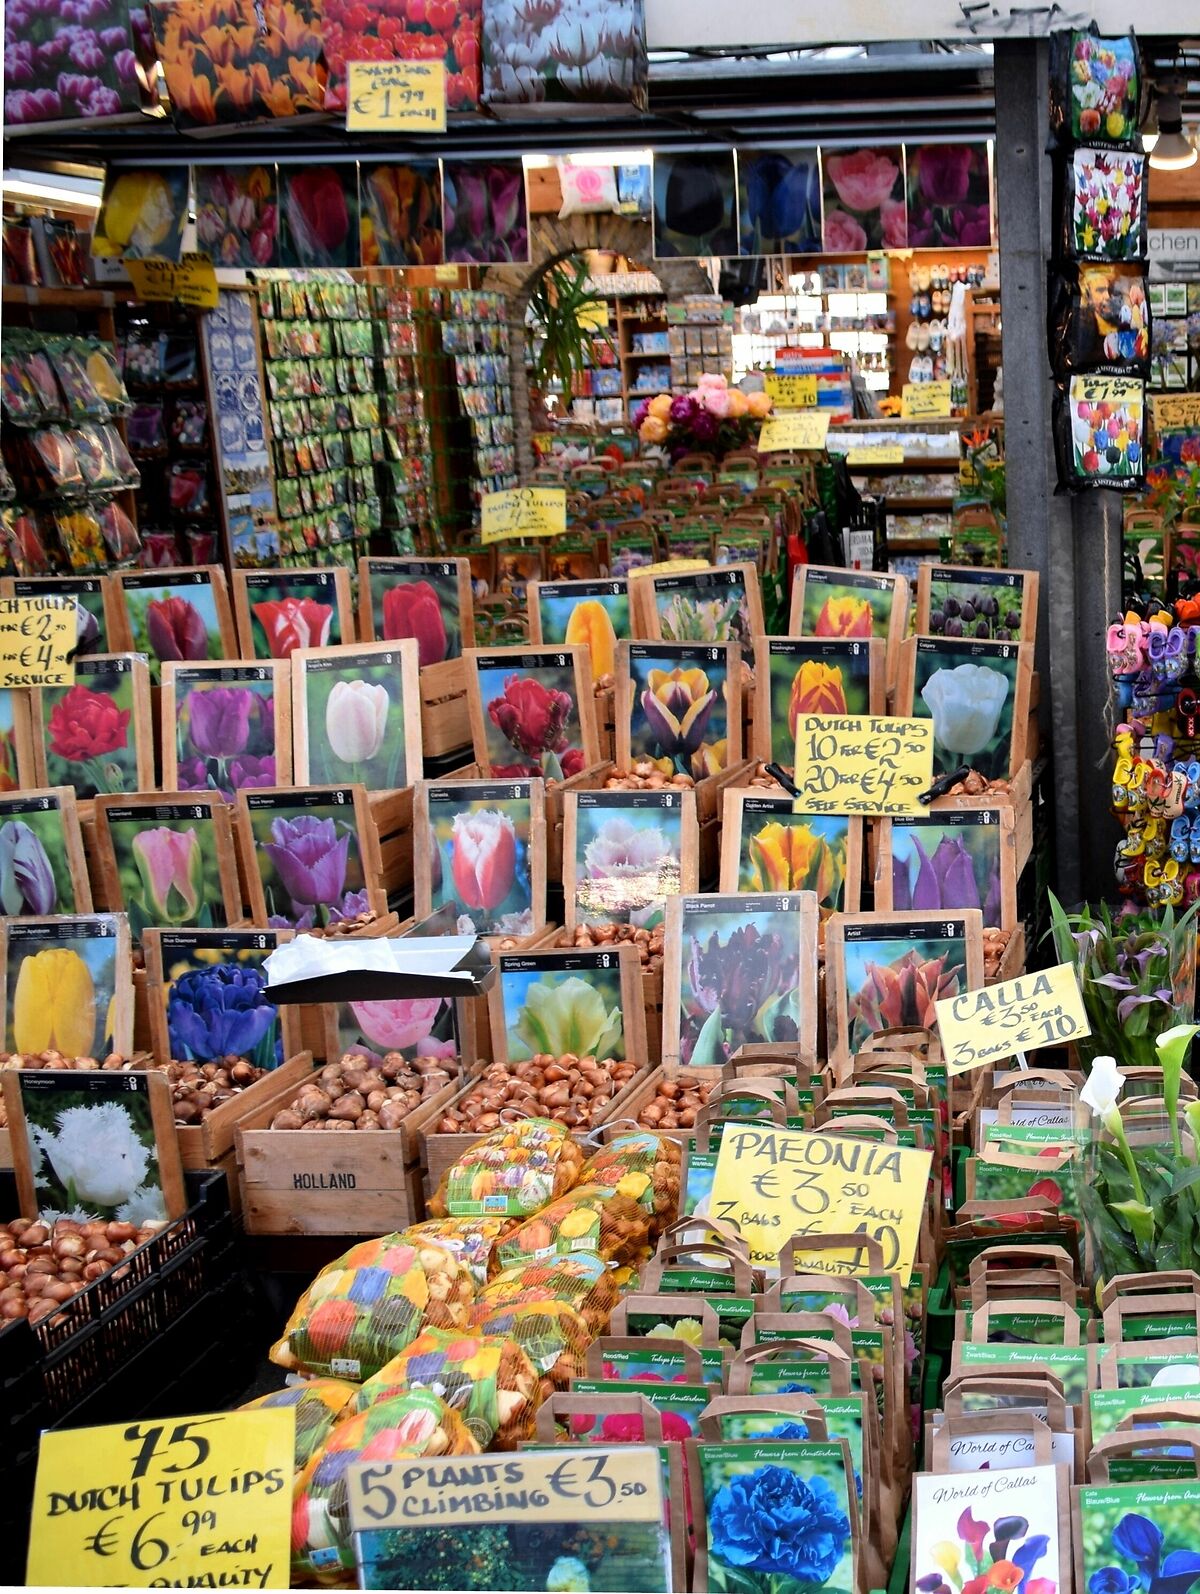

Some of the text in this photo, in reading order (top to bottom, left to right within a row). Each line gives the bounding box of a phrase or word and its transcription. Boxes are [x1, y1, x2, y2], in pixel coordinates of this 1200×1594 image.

[919, 642, 936, 650] Calgary
[4, 673, 66, 686] SERVICE
[805, 717, 928, 737] DUTCH TULIPS
[806, 733, 838, 761] 10
[840, 745, 864, 756] FOR
[804, 765, 839, 794] 20
[838, 774, 861, 784] FOR
[805, 798, 914, 813] SELF SERVICE
[952, 974, 1054, 1021] CALLA
[1030, 1005, 1062, 1021] EACH
[952, 1040, 976, 1066] 3
[24, 1079, 55, 1087] Honeymoon
[730, 1132, 902, 1183] PAEONIA
[293, 1173, 356, 1189] HOLLAND
[741, 1211, 781, 1226] BAGS
[850, 1203, 903, 1225] EACH
[716, 1305, 751, 1313] Amsterdam
[1140, 1393, 1182, 1405] Flowers from
[124, 1417, 226, 1480] 75
[754, 1448, 840, 1459] Flowers from Amsterdam
[951, 1440, 1013, 1454] World of
[47, 1468, 285, 1517] DUTCH TULIPS
[360, 1464, 397, 1520] 5
[402, 1462, 525, 1490] PLANTS
[932, 1475, 1037, 1503] World of Callas
[1136, 1493, 1160, 1504] Flowers
[1161, 1492, 1181, 1504] from
[402, 1486, 550, 1517] CLIMBING
[200, 1534, 258, 1556] EACH
